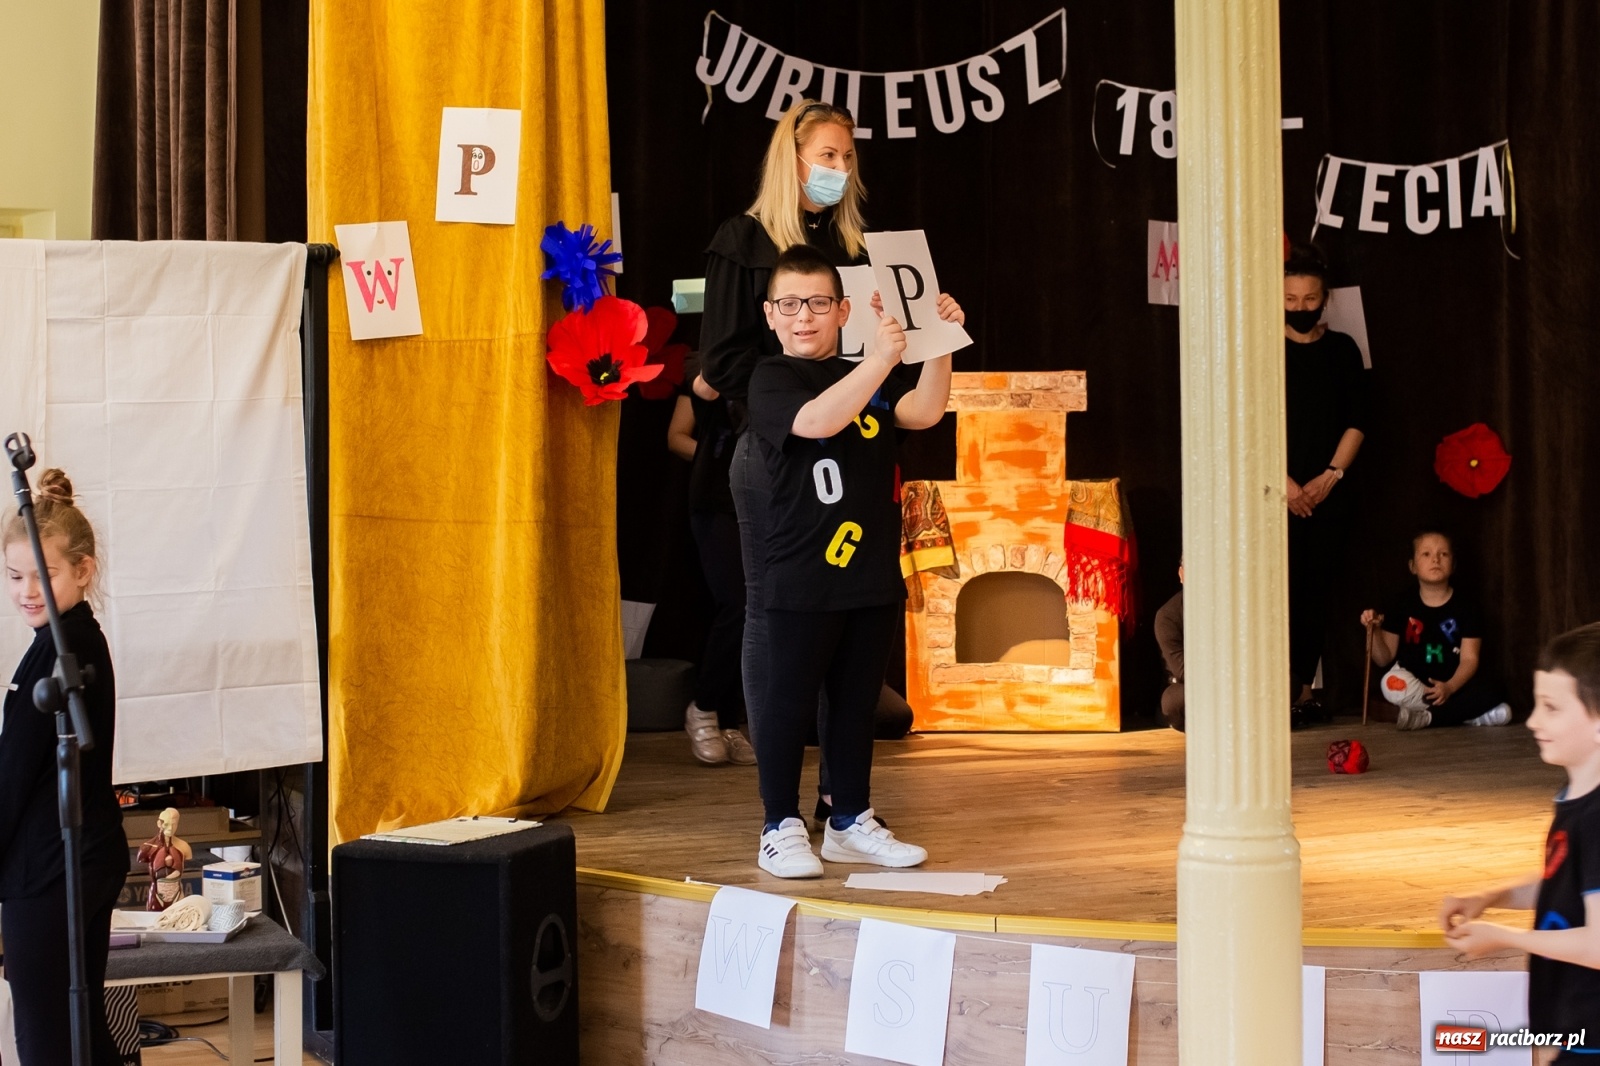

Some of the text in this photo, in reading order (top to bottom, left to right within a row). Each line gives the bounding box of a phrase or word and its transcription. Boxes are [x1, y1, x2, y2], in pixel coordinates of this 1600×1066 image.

[454, 144, 496, 195] P
[1319, 146, 1505, 235] LECIA
[346, 257, 404, 313] W
[886, 264, 925, 331] P
[825, 522, 863, 568] G
[1405, 616, 1424, 645] R
[1426, 643, 1444, 663] H
[711, 915, 774, 990] W
[873, 960, 915, 1028] S
[1042, 981, 1109, 1054] U
